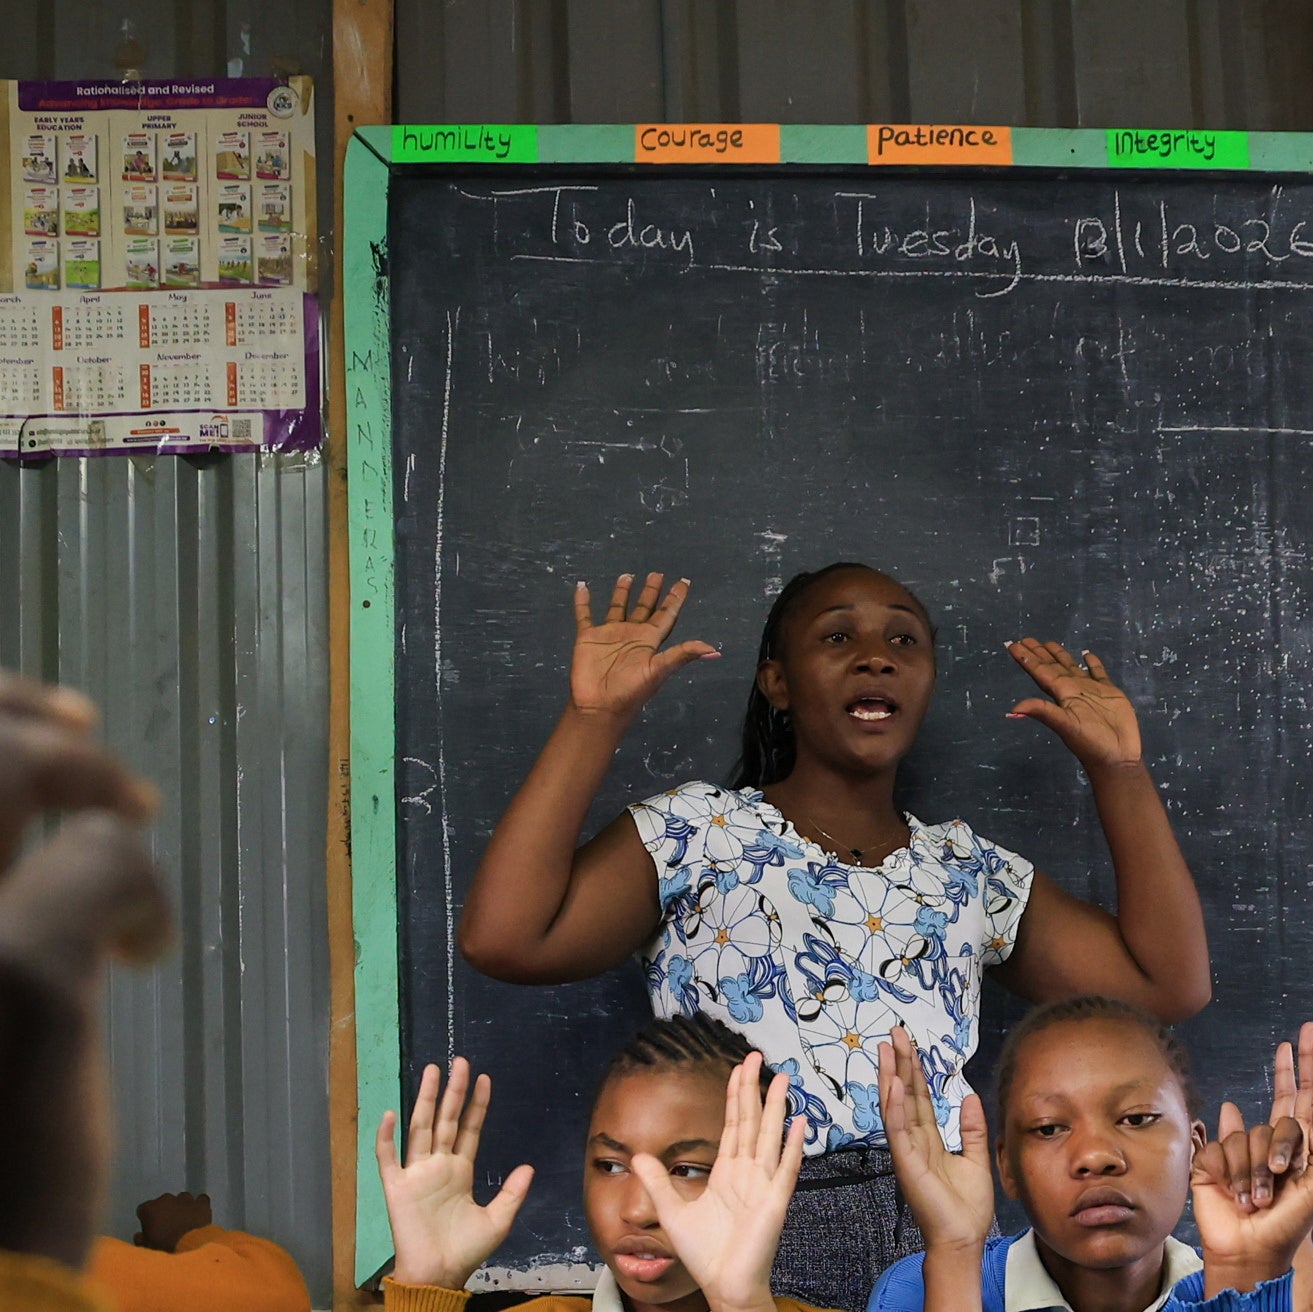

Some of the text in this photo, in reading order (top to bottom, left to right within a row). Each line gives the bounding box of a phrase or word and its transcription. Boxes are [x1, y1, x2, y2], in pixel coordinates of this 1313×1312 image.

[76, 84, 214, 96] Rationalised and Revised
[492, 186, 695, 273] Today
[748, 199, 783, 254] is
[834, 191, 1023, 298] Tuesday
[80, 296, 100, 304] April
[169, 293, 187, 302] May
